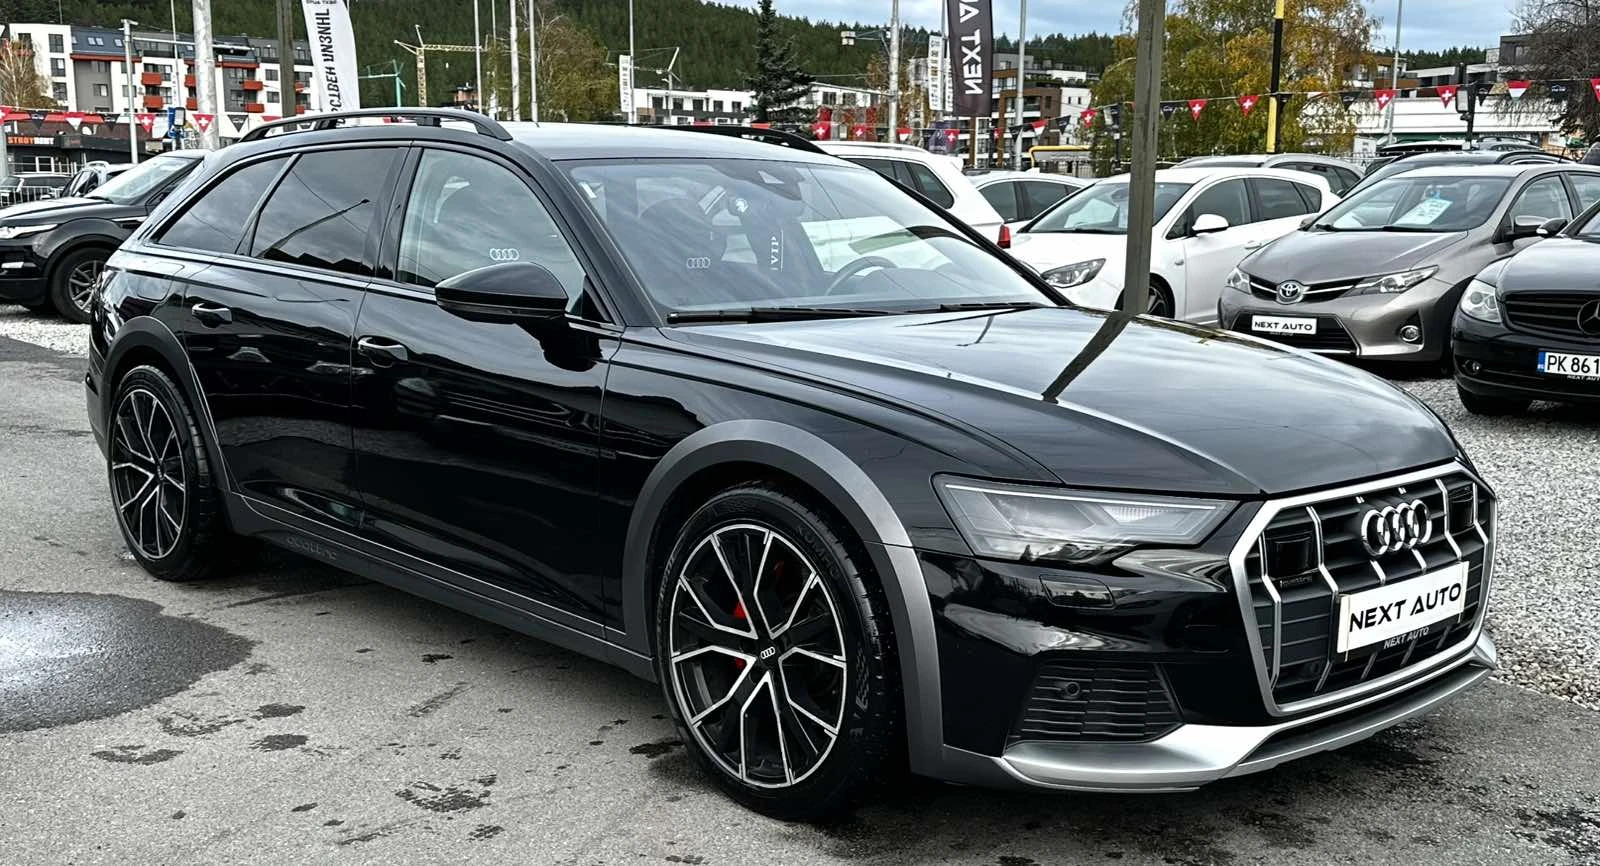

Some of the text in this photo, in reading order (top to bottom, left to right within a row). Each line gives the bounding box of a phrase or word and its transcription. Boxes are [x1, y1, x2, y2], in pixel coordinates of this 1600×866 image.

[1254, 321, 1313, 331] NEXT AUTO
[1547, 355, 1600, 375] PK 861
[1349, 582, 1462, 633] NEXT AUTO
[1383, 626, 1430, 650] NEXT AUTO
